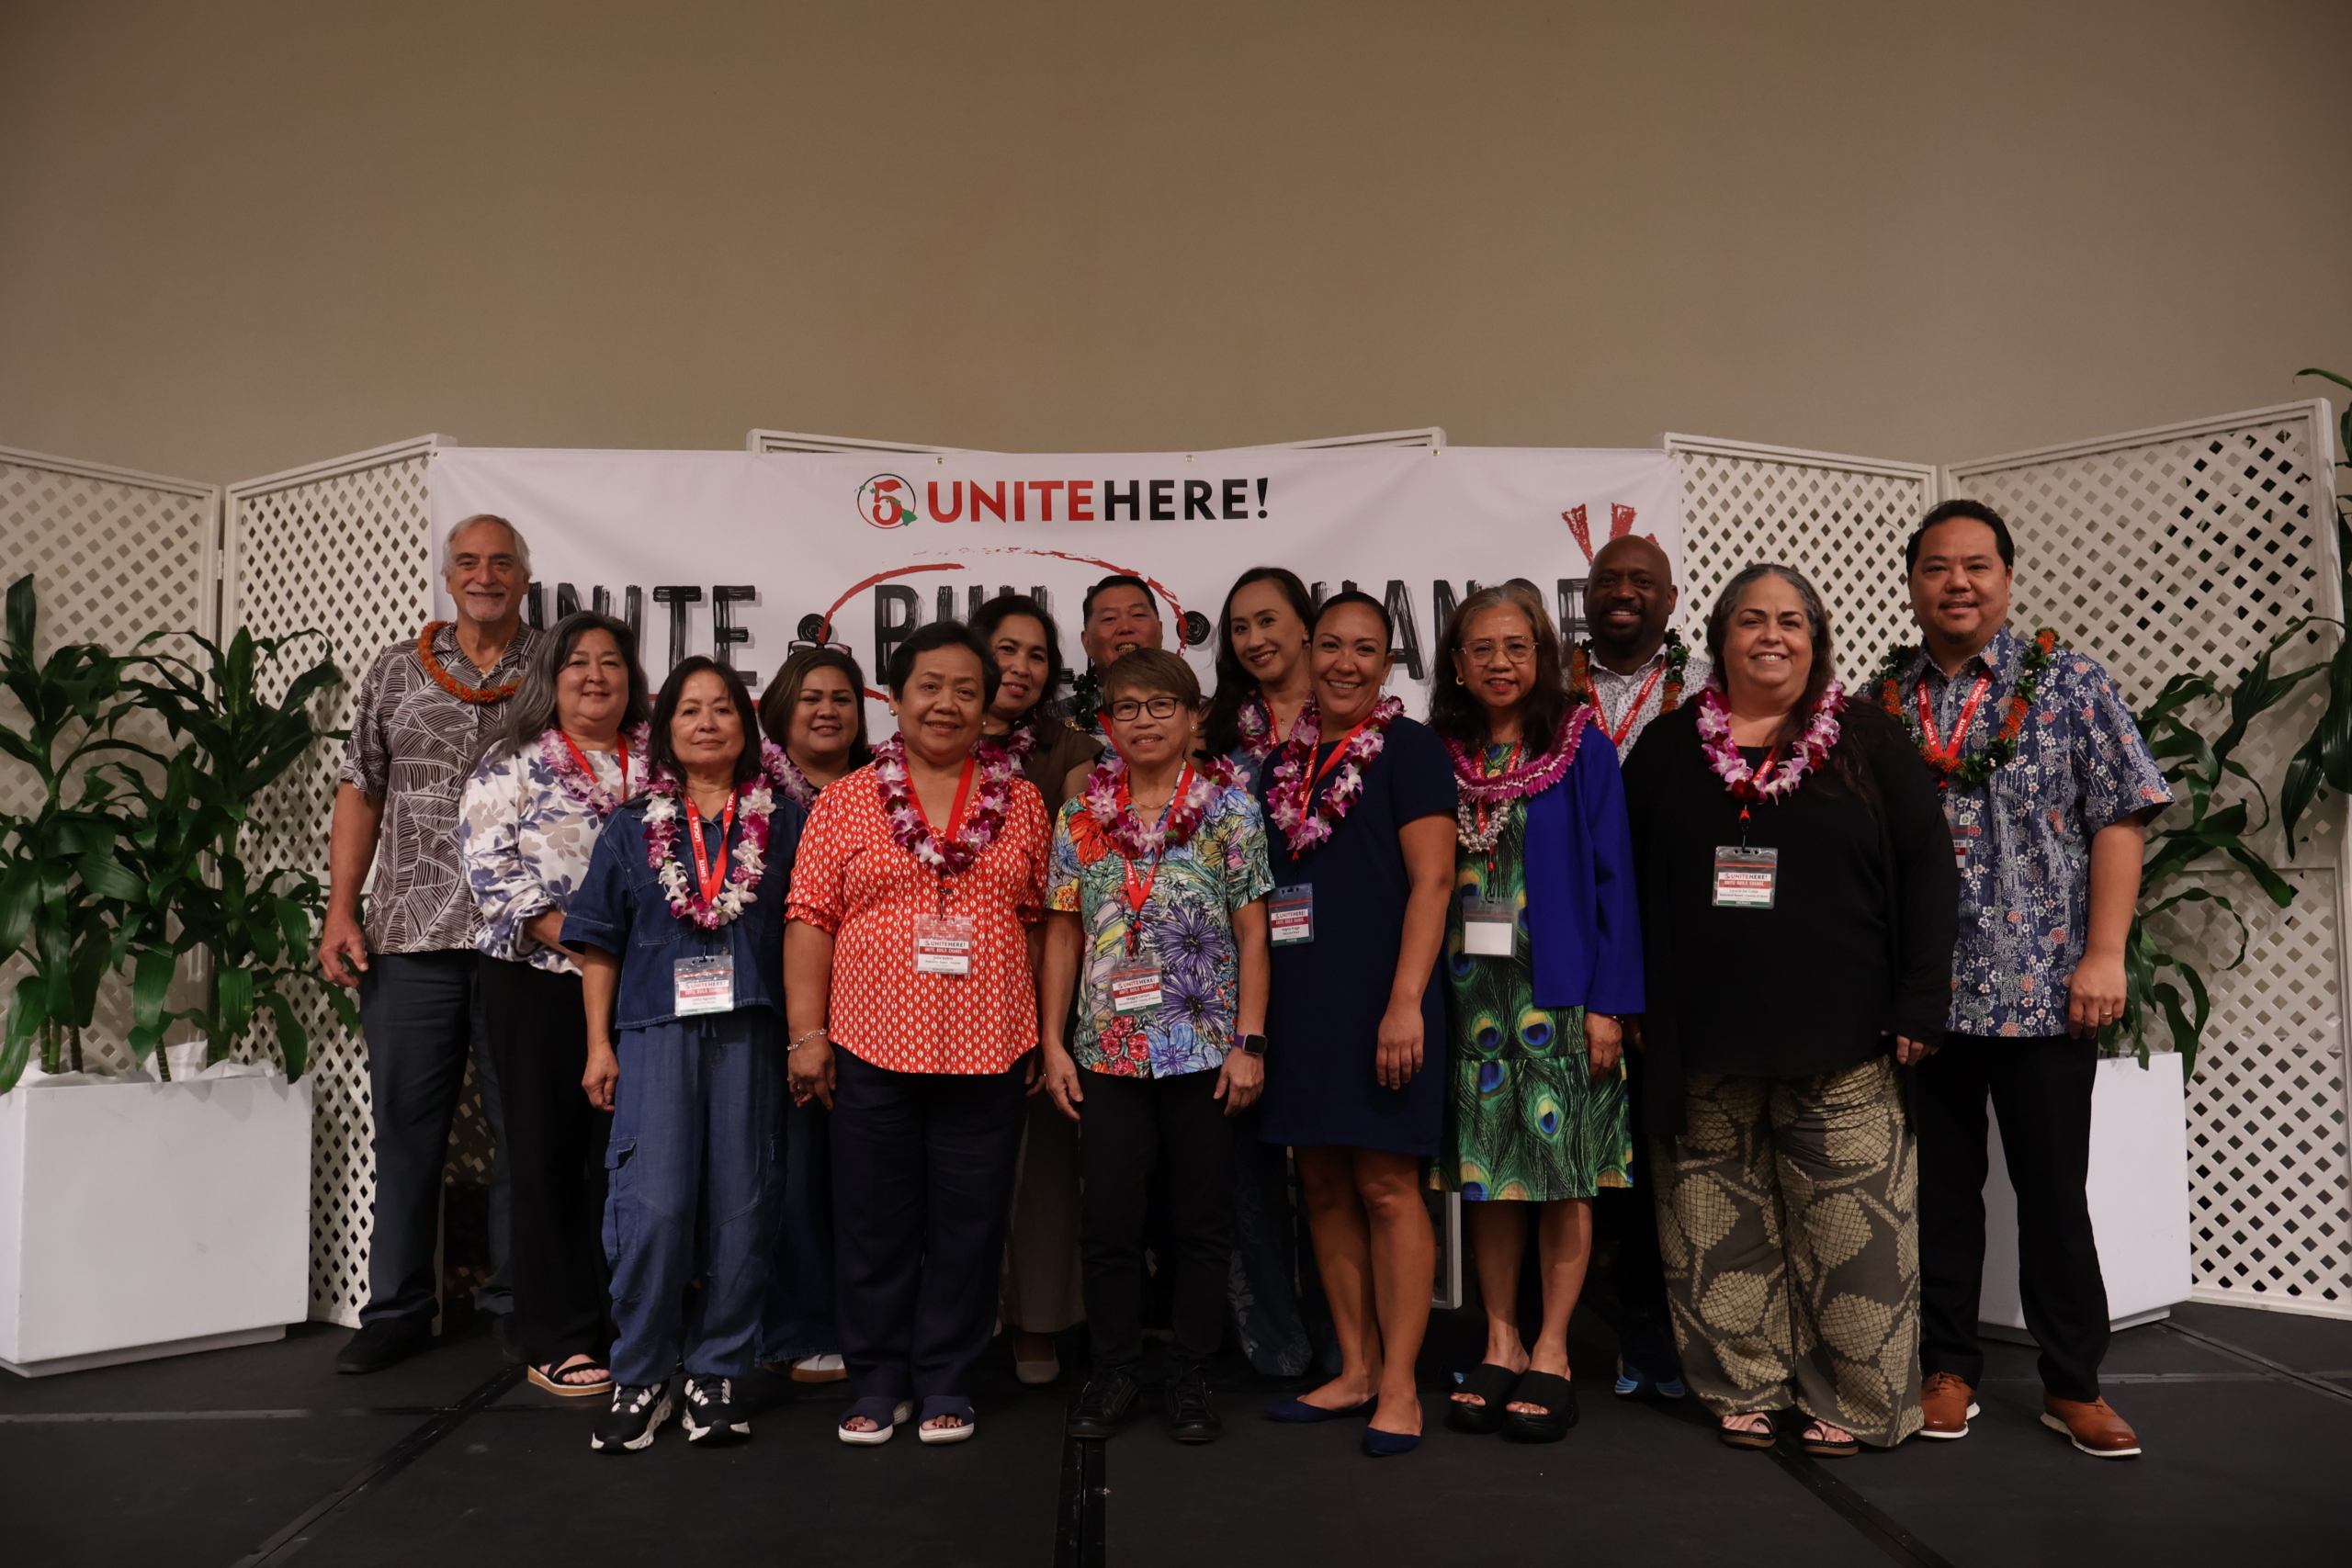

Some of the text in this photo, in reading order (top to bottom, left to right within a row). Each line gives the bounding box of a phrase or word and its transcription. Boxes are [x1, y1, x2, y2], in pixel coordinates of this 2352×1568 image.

[1642, 678, 1654, 695] LOCAL
[1971, 683, 1984, 703] LOCAL
[1924, 719, 1933, 740] LOCAL
[693, 821, 701, 842] LOCAL
